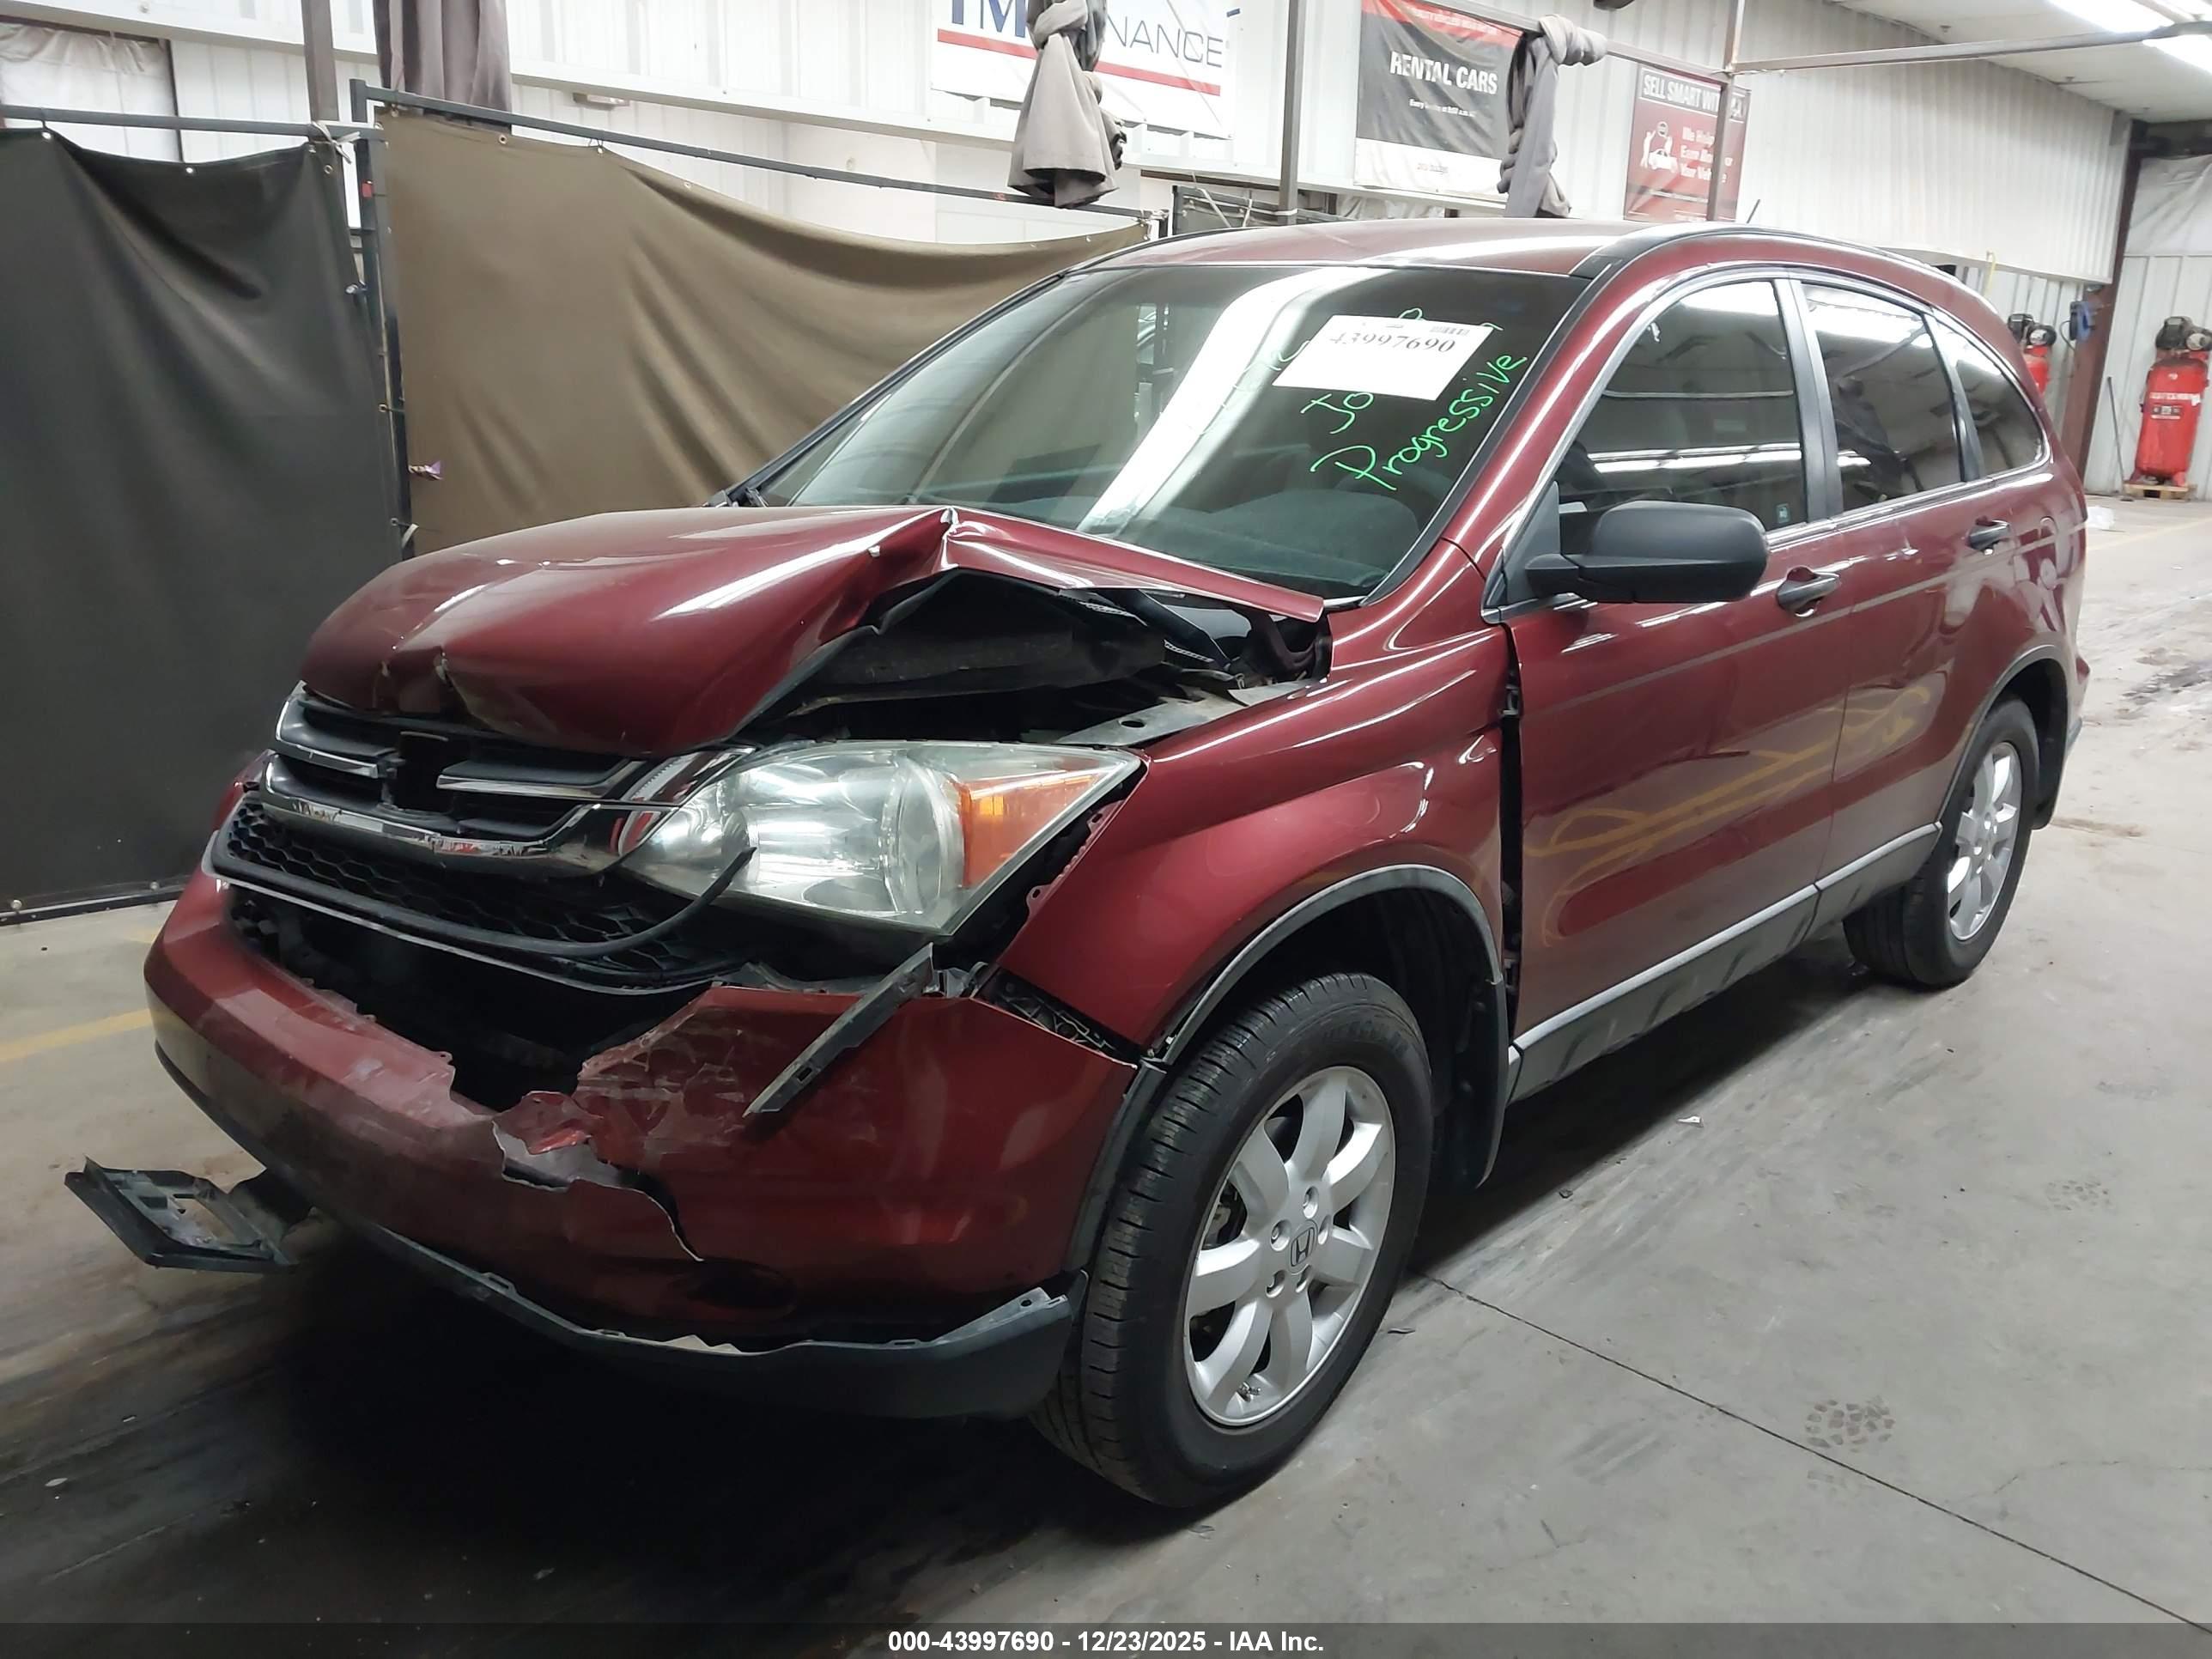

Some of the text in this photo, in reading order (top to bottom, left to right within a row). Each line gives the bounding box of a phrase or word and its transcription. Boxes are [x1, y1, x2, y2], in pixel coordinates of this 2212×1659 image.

[1389, 51, 1498, 94] RENTAL CARS
[1643, 74, 1666, 100] SELL
[1667, 81, 1701, 108] SMART
[1329, 331, 1456, 353] 43997690
[1310, 355, 1528, 492] Progressive
